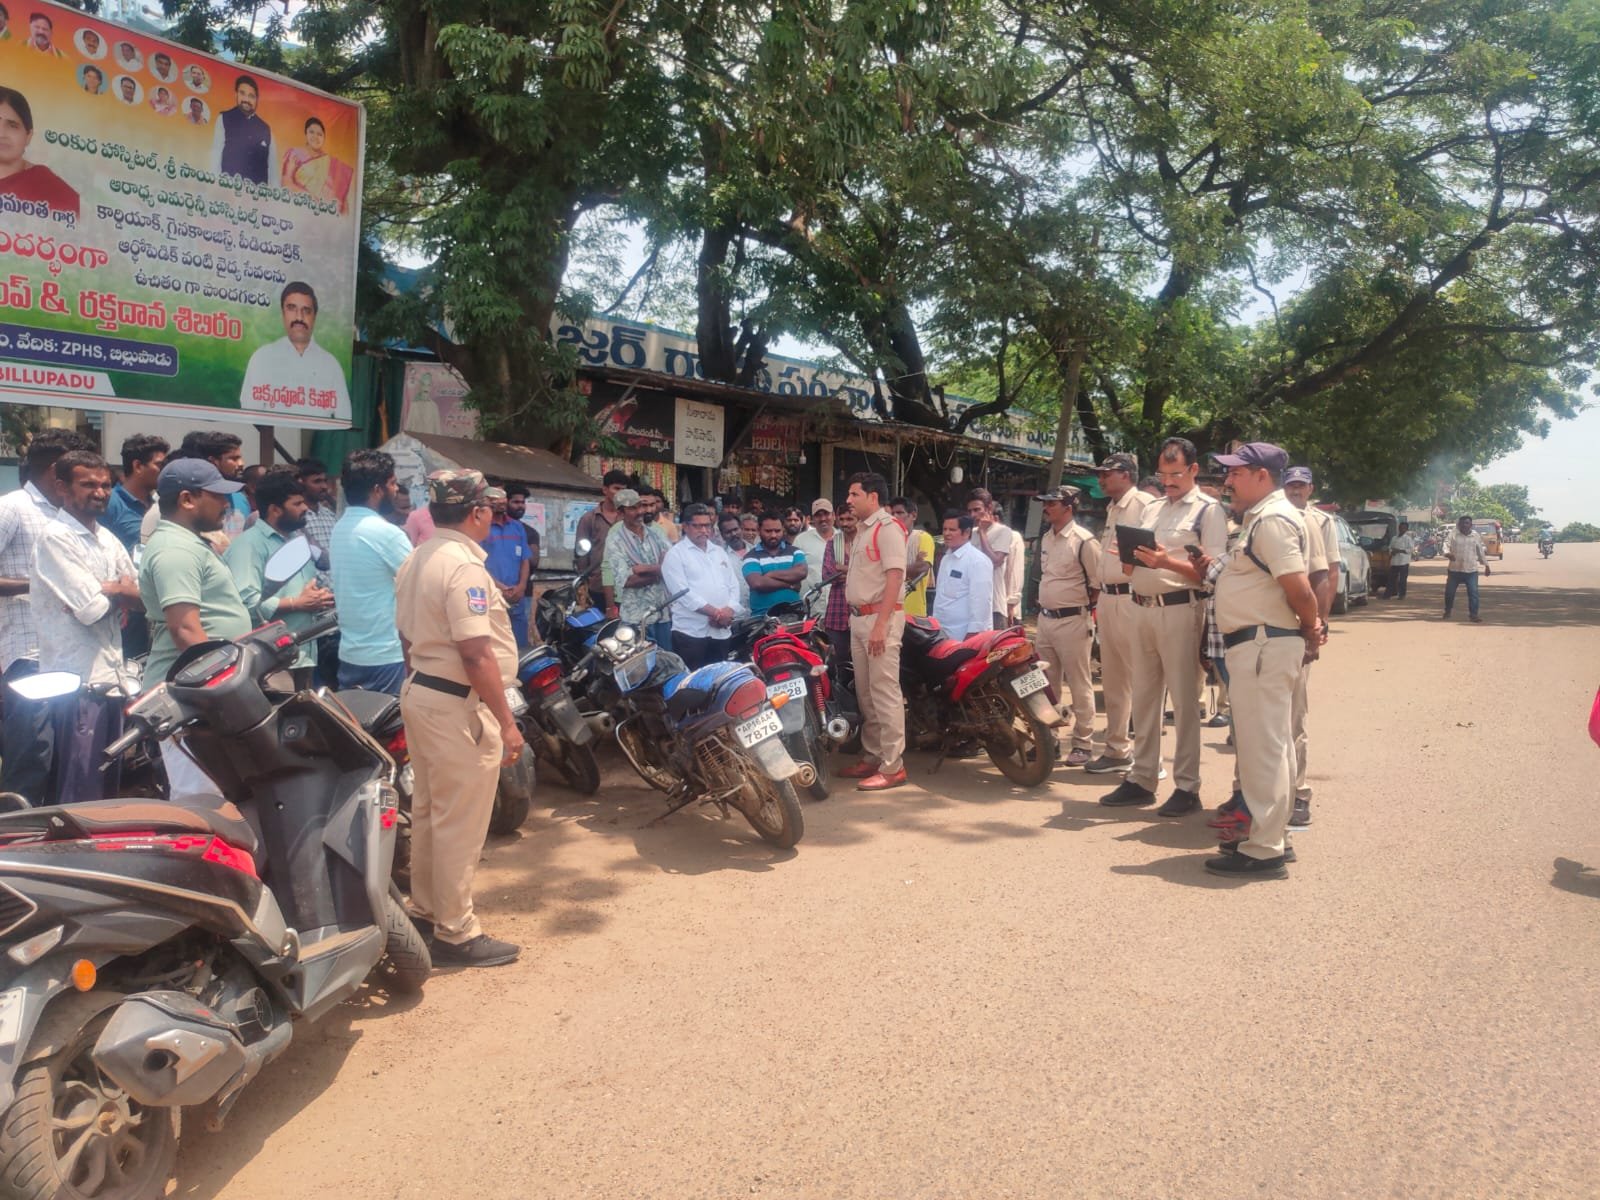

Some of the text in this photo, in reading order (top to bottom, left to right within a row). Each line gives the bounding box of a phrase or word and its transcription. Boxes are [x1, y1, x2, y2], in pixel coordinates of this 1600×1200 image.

[44, 129, 97, 154] అంకుర
[0, 194, 49, 219] మలత
[261, 214, 294, 235] ద్వారా
[135, 268, 181, 292] ఉచితం
[184, 281, 201, 295] గా
[40, 281, 70, 315] &
[79, 291, 166, 331] రక్తదాన
[173, 307, 242, 341] శిబిరం
[61, 341, 107, 361] ZPHS,
[745, 722, 778, 744] 7876
